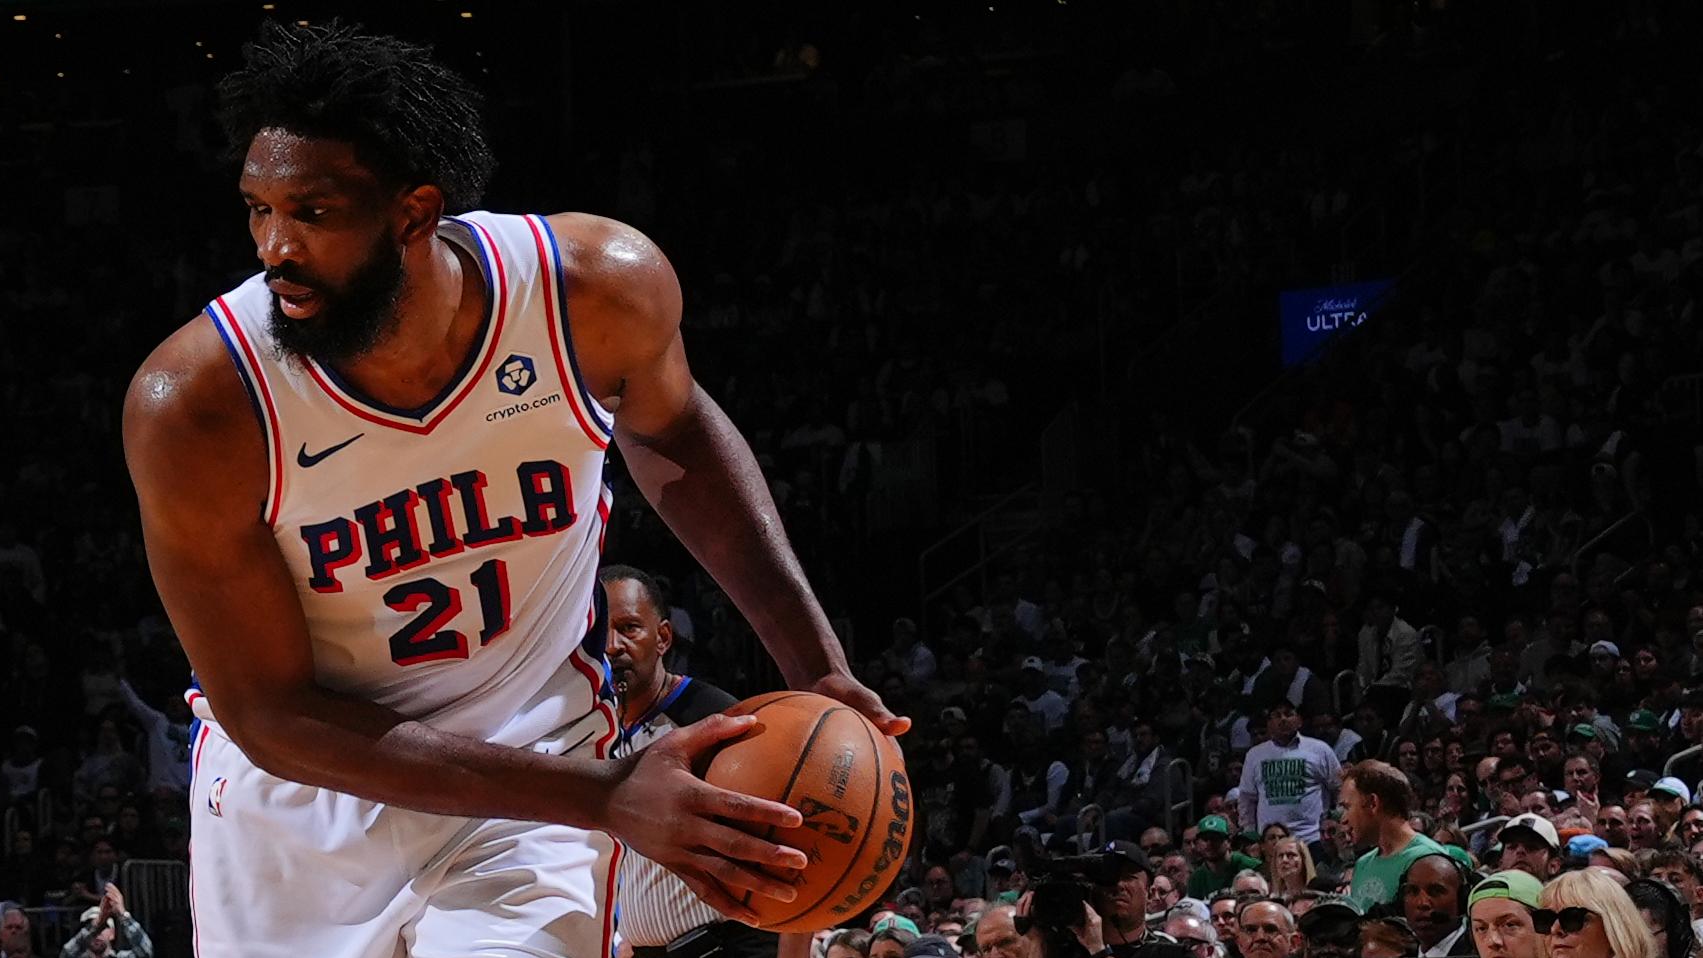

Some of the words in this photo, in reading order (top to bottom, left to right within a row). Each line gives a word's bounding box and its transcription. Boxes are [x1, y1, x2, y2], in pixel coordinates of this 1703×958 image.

[485, 393, 561, 422] crypto.com
[299, 458, 578, 594] PHILA
[382, 558, 512, 667] 21
